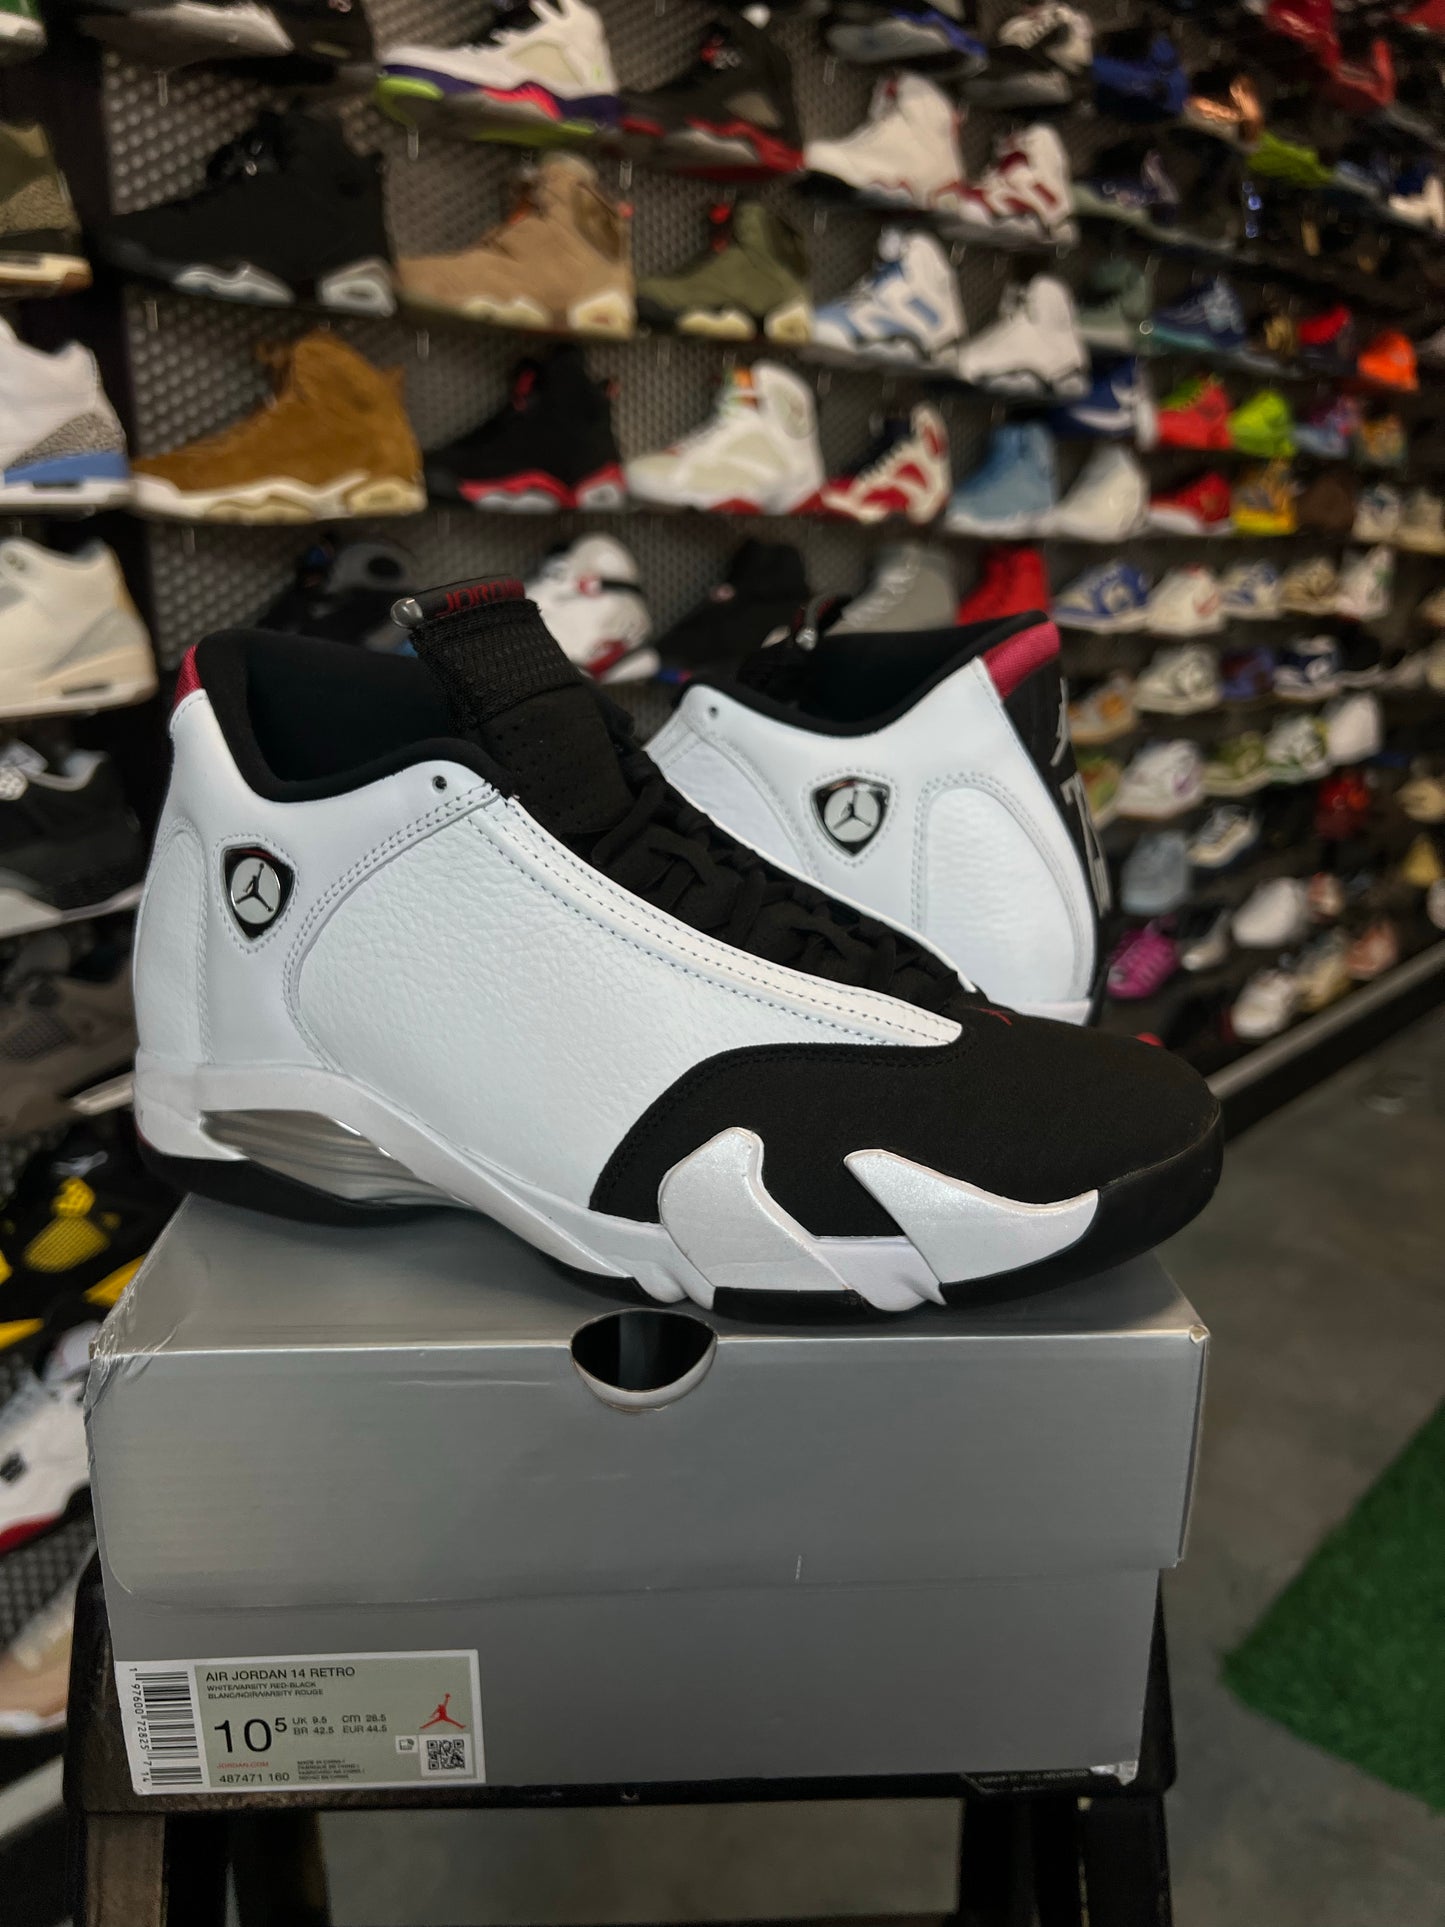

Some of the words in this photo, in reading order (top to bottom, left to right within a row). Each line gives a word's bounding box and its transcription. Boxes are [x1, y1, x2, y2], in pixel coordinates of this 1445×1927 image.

[205, 1671, 228, 1682] AIR
[231, 1668, 287, 1681] JORDAN
[291, 1668, 306, 1678] 14
[310, 1666, 355, 1678] RETRO
[295, 1688, 324, 1696] ROUGE
[131, 1683, 144, 1715] 97600
[292, 1716, 308, 1725] UK
[137, 1720, 150, 1751] 72825
[293, 1726, 309, 1735] BR
[313, 1725, 335, 1735] 42.5
[342, 1725, 364, 1734] EUR
[366, 1724, 388, 1733] 44.5
[219, 1772, 263, 1783] 487471
[268, 1771, 290, 1782] 160
